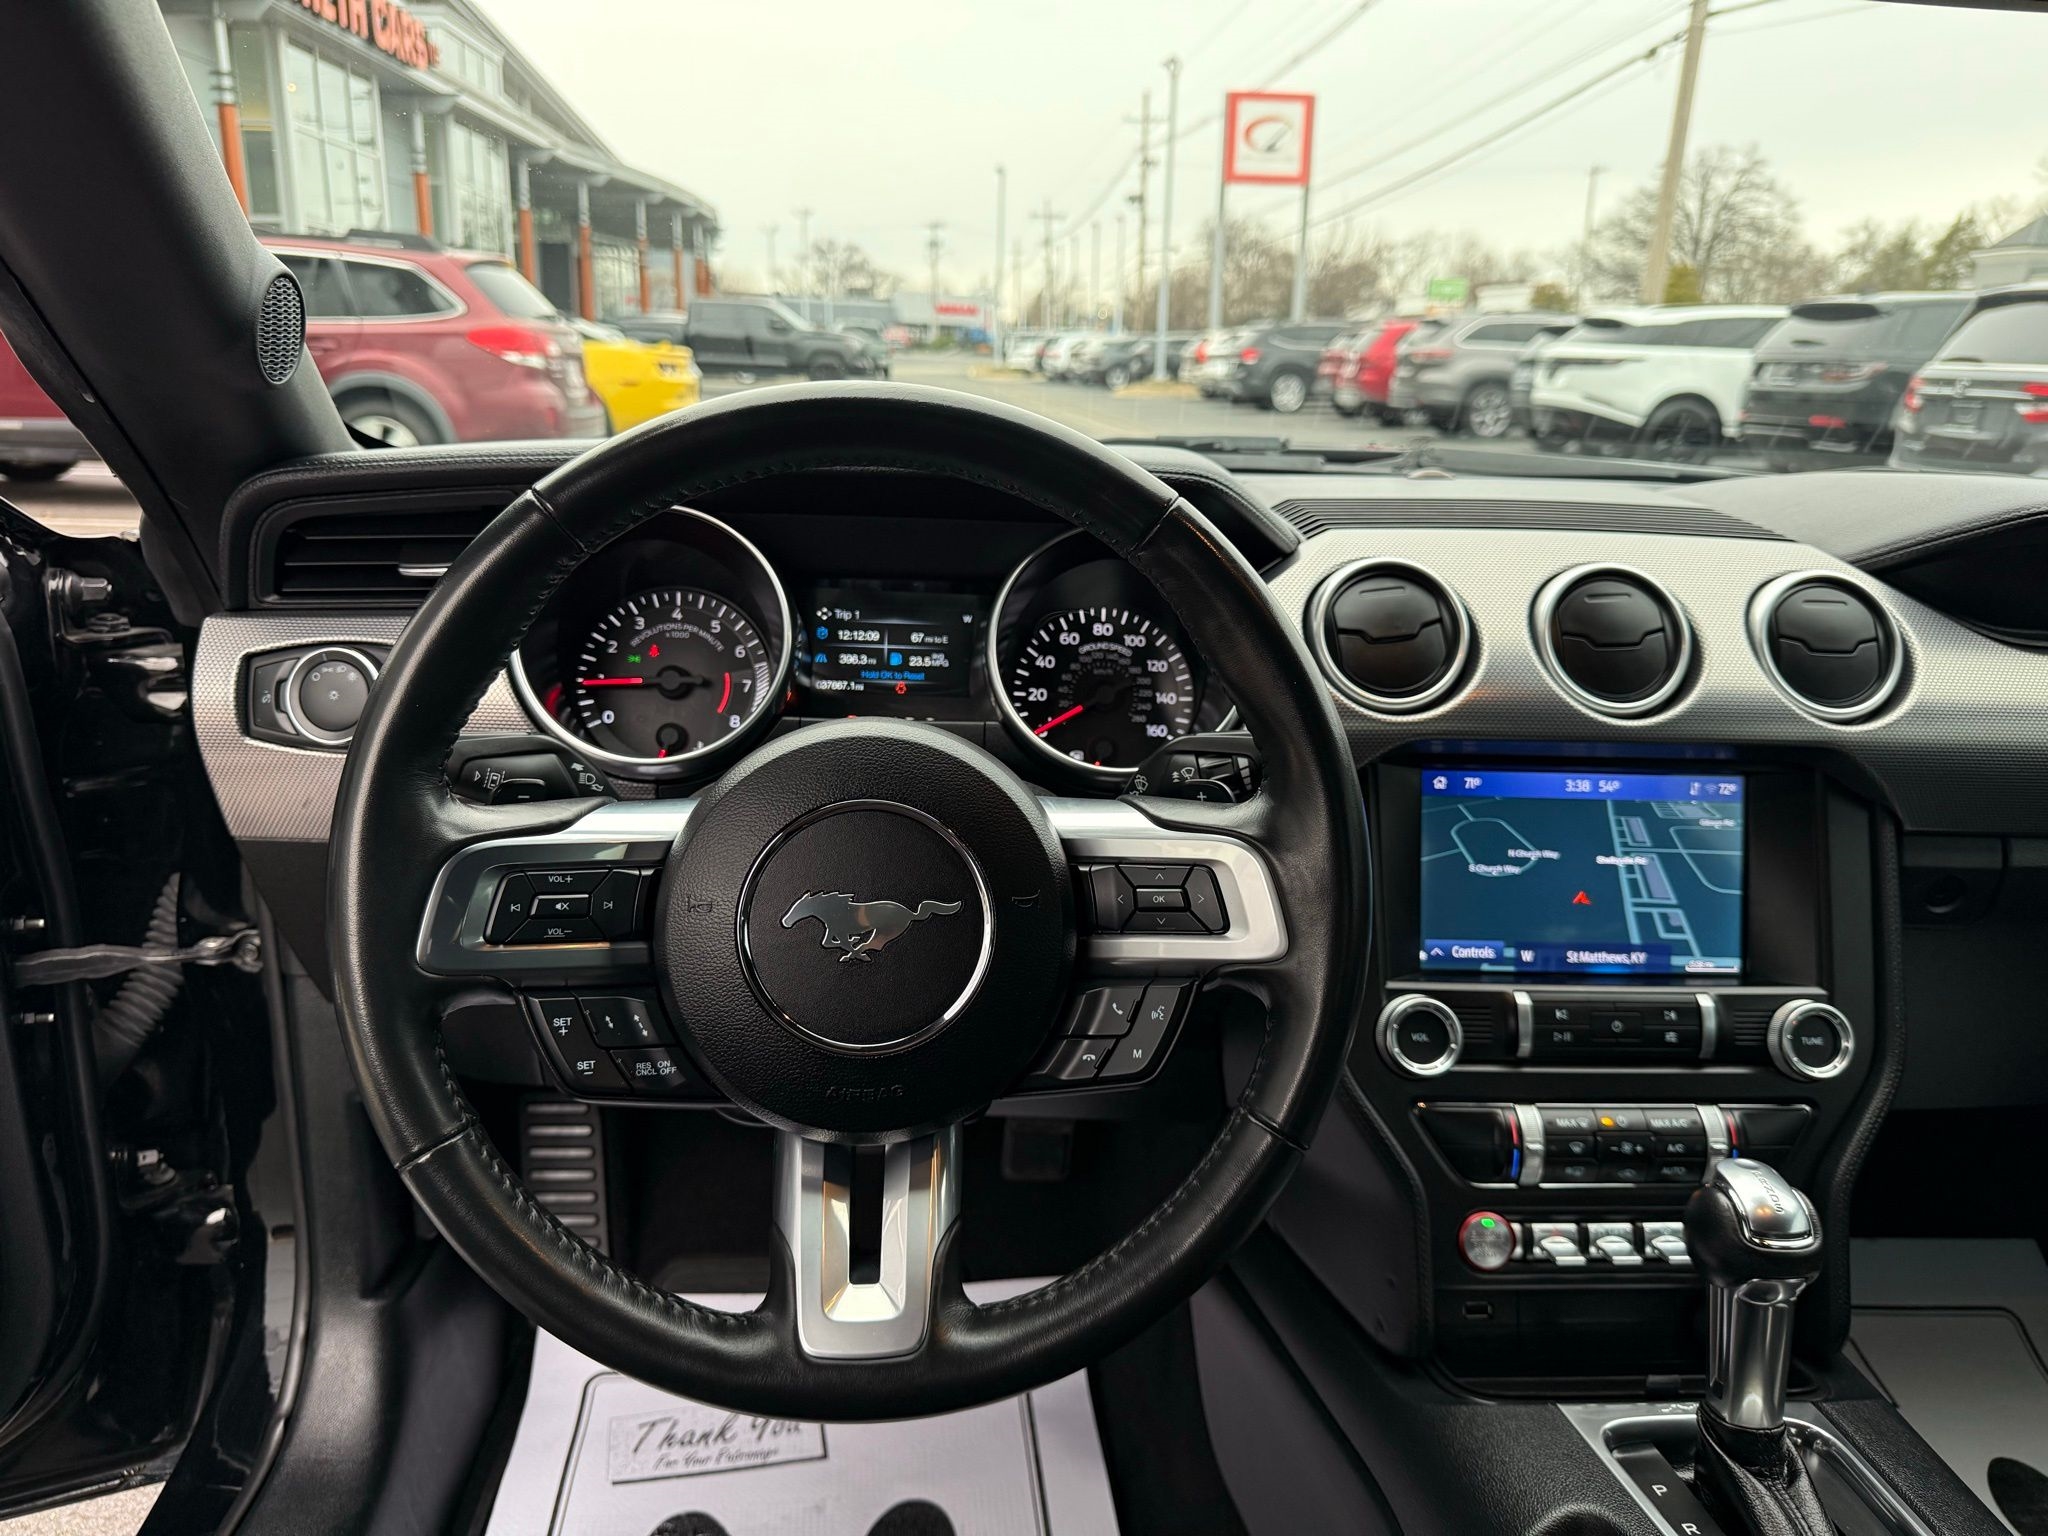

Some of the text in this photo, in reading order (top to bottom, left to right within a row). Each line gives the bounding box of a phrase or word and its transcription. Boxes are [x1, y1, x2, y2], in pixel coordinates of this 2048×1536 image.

[672, 608, 683, 621] 4
[834, 608, 852, 621] Trip
[634, 616, 646, 630] 3
[711, 620, 721, 633] 5
[1092, 622, 1114, 636] 80
[837, 629, 880, 641] 12:12:09
[910, 632, 924, 643] 67
[1059, 632, 1080, 646] 60
[1123, 634, 1147, 648] 100
[607, 640, 618, 654] 2
[735, 645, 746, 658] 6
[1035, 655, 1056, 669] 40
[1147, 659, 1169, 673] 120
[742, 679, 752, 693] 7
[1028, 687, 1048, 701] 20
[1155, 691, 1177, 705] 140
[602, 710, 615, 724] 0
[729, 714, 741, 728] 8
[1146, 724, 1169, 738] 160
[1152, 895, 1166, 904] OK
[1451, 944, 1497, 960] Controls
[1520, 949, 1536, 963] W
[553, 1017, 573, 1027] SET
[1800, 1036, 1825, 1046] TUNE
[1132, 1049, 1143, 1059] M
[577, 1060, 596, 1070] SET
[635, 1066, 677, 1077] CNCL OFF
[636, 1060, 671, 1070] RES ON
[1666, 1143, 1686, 1152] A/C
[632, 1413, 739, 1455] Thank
[1652, 1484, 1668, 1497] P
[1681, 1522, 1701, 1536] R
